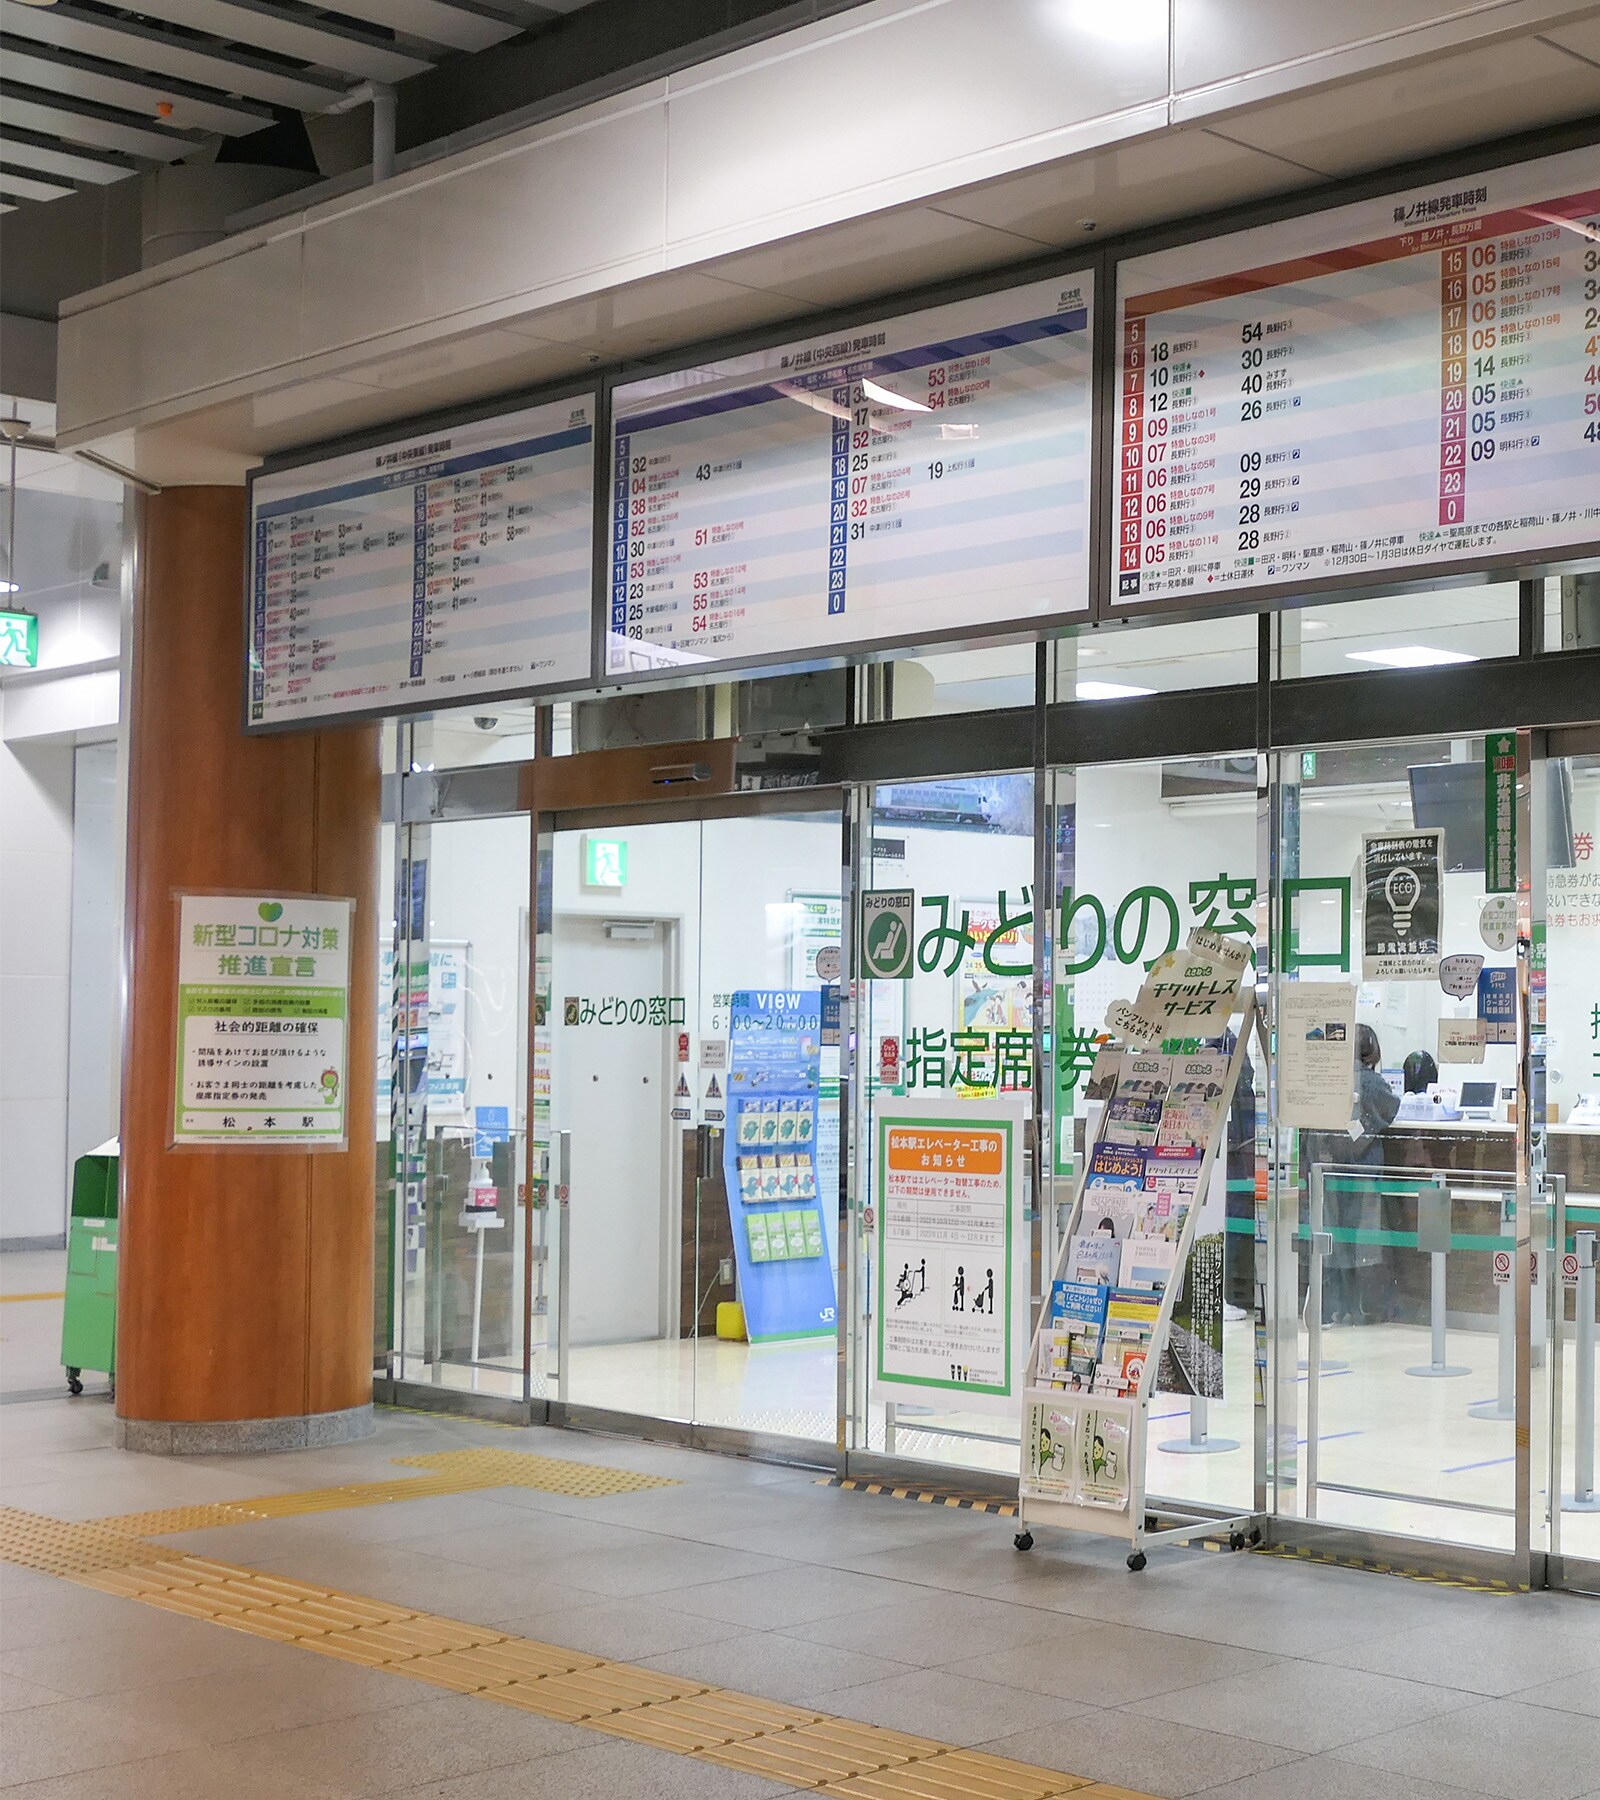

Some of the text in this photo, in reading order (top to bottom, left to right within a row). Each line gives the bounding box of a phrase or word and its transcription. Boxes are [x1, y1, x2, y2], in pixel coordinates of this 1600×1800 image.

[1448, 254, 1462, 272] 15
[1472, 244, 1496, 268] 06
[1242, 322, 1262, 344] 54
[1151, 342, 1169, 363] 18
[927, 367, 946, 387] 53
[1474, 355, 1495, 379] 14
[1151, 367, 1168, 388] 10
[1148, 418, 1168, 438] 09
[1241, 400, 1262, 422] 26
[632, 456, 647, 474] 32
[927, 462, 943, 480] 19
[1240, 452, 1261, 473] 09
[1147, 468, 1167, 488] 06
[695, 529, 708, 546] 51
[1145, 544, 1165, 564] 05
[1238, 530, 1259, 551] 28
[630, 541, 645, 557] 30
[629, 584, 643, 600] 23
[1393, 882, 1413, 895] ECO
[865, 895, 911, 908] みどりの窓口
[918, 873, 1352, 979] みどりの窓口
[192, 924, 339, 950] 新型コロナ対策
[218, 954, 317, 978] 推進宣言
[1153, 979, 1237, 997] チケットレス
[580, 996, 687, 1028] みどりの窓口
[1164, 1000, 1216, 1016] サービス
[214, 1021, 318, 1034] 社会的距離の確保
[891, 1136, 997, 1152] 松本駅エレベーター工事の
[921, 1154, 966, 1167] お知らせ
